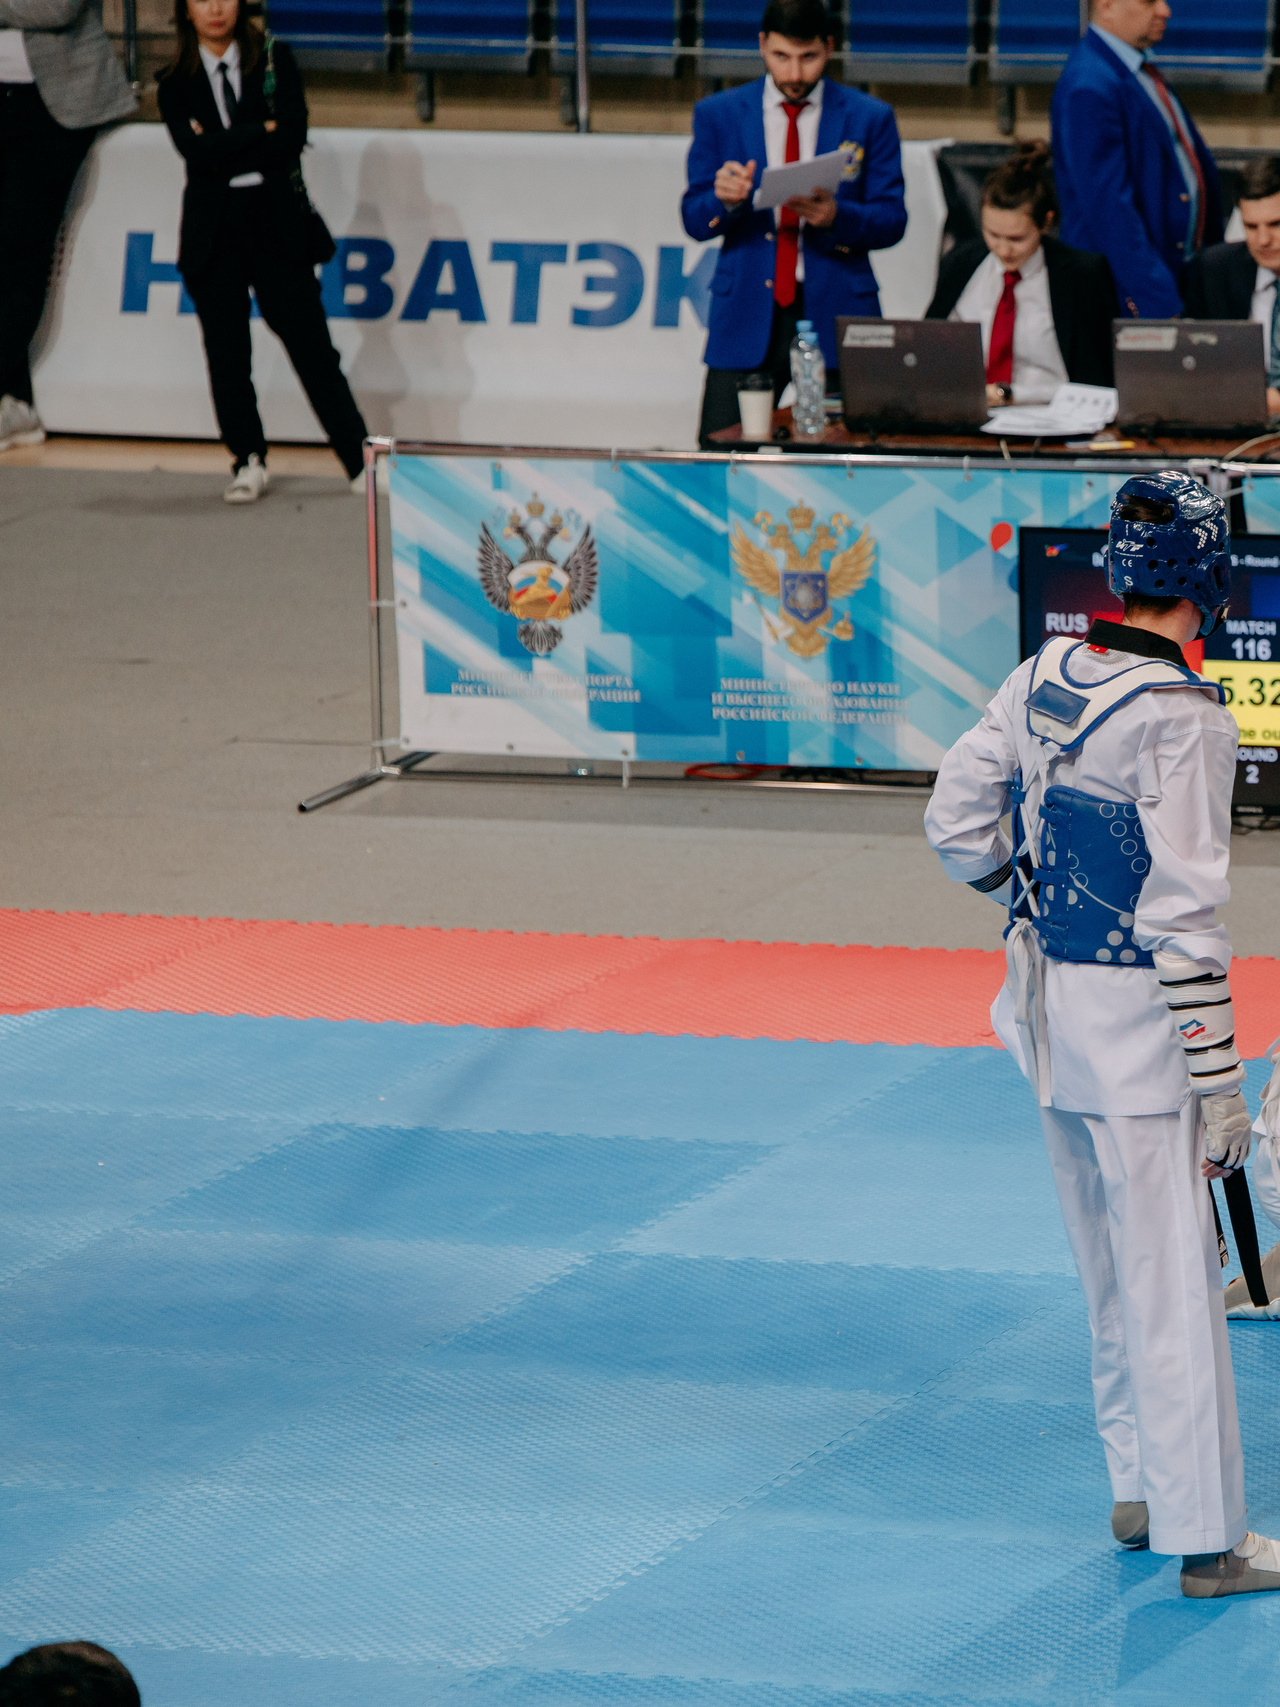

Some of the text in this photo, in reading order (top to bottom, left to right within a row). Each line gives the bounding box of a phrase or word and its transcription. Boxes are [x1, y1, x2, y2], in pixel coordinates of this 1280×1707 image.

[121, 231, 712, 331] НВАТЭК
[1245, 554, 1279, 568] Round
[1123, 576, 1134, 587] S
[1045, 612, 1089, 633] RUS
[1226, 620, 1277, 636] MATCH
[1231, 638, 1272, 660] 116
[847, 681, 901, 696] НАУКИ
[711, 692, 724, 705] И
[712, 706, 813, 722] РОССИЙСКОЙ
[1236, 746, 1279, 763] OUND
[1245, 764, 1260, 784] 2
